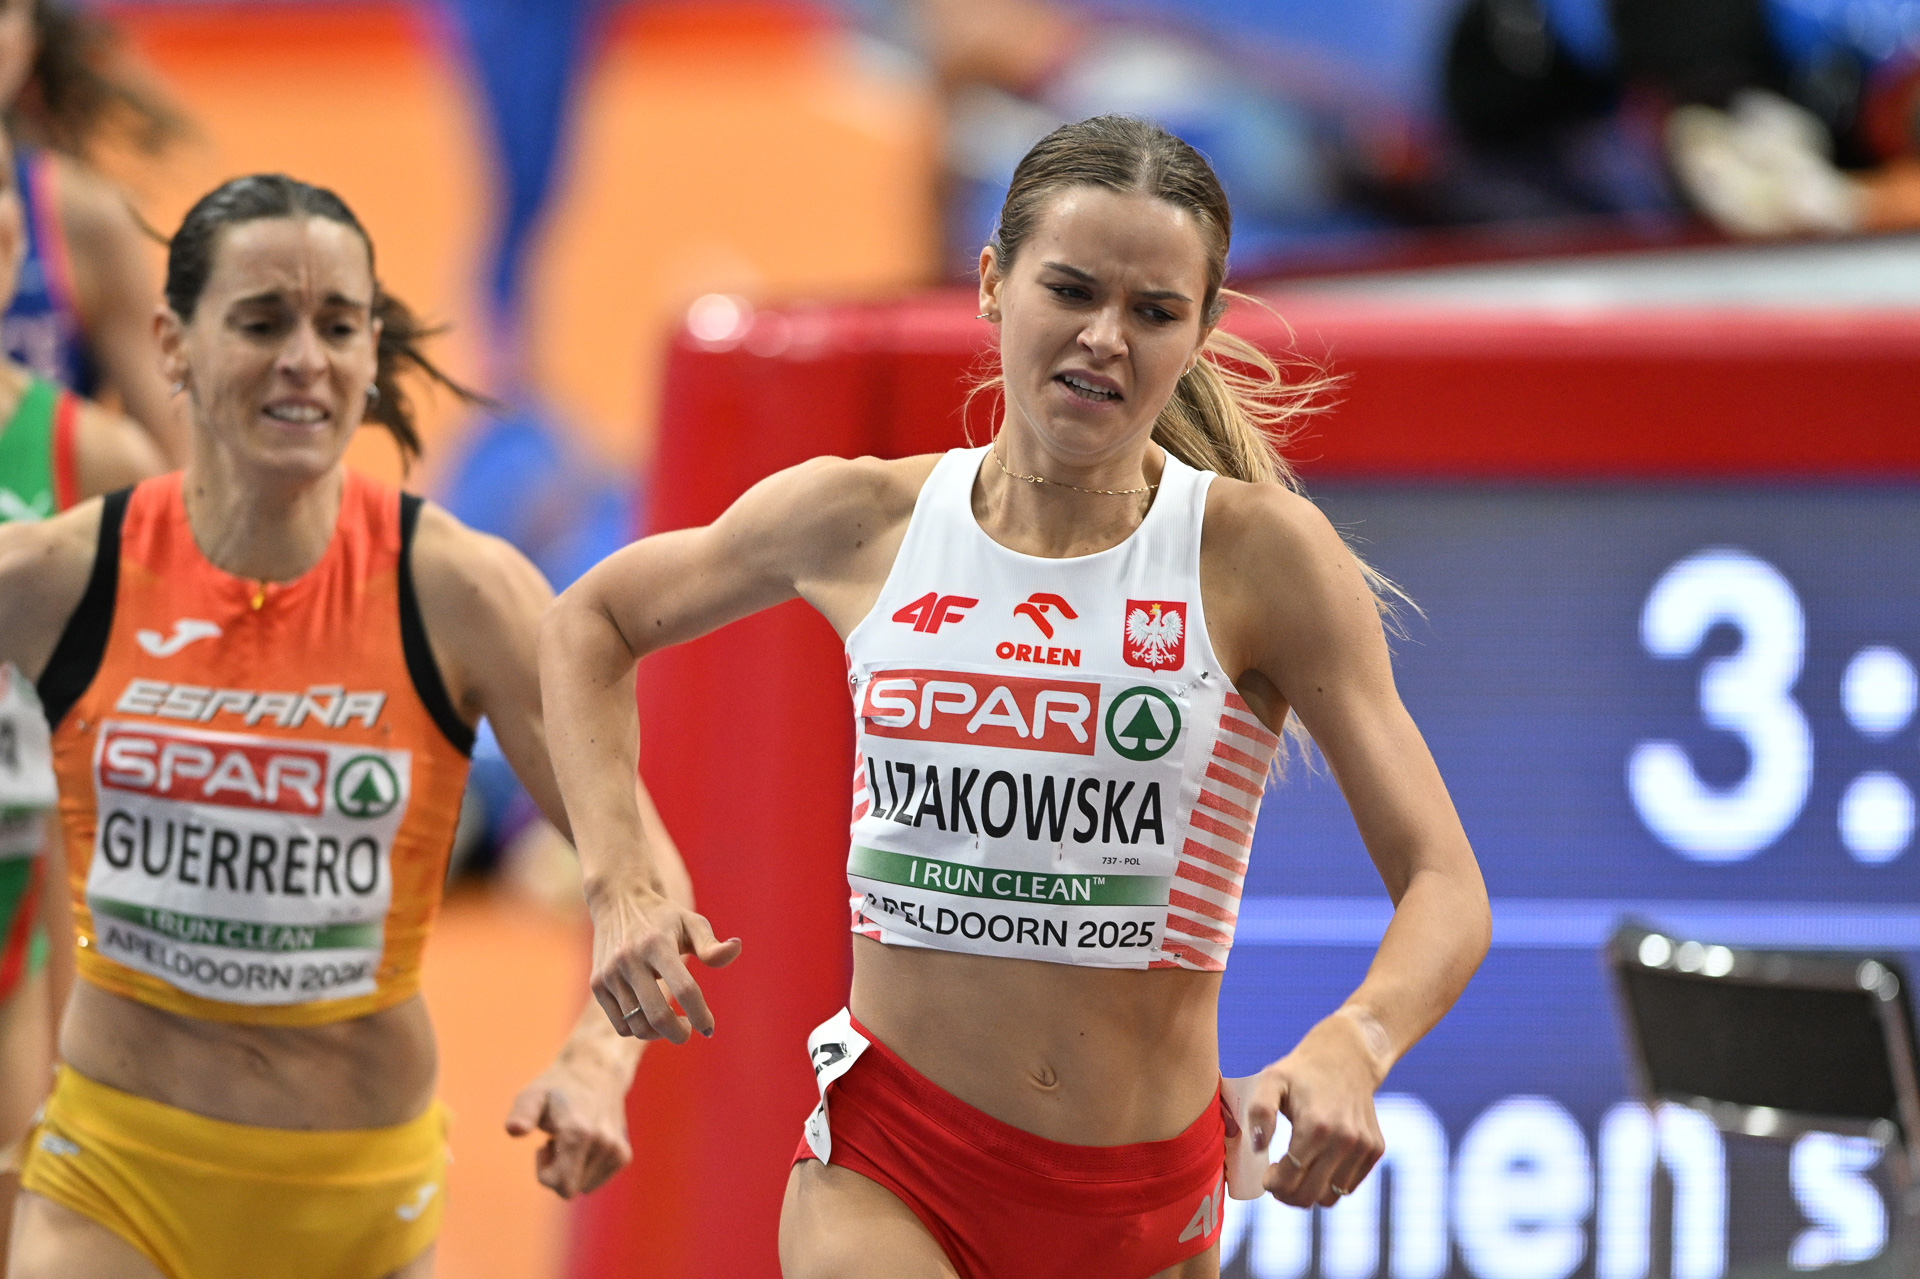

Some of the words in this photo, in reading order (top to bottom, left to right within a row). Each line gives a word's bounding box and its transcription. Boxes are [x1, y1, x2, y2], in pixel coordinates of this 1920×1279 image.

[891, 591, 980, 635] 4F
[995, 641, 1082, 668] ORLEN
[115, 678, 387, 729] ESPAÑA
[869, 679, 1092, 744] SPAR
[106, 737, 322, 808] SPAR
[868, 757, 1165, 845] LIZAKOWSKA
[102, 808, 381, 896] GUERRERO
[1102, 857, 1117, 865] 737
[1125, 857, 1141, 865] POL
[909, 860, 918, 883] I
[923, 862, 984, 893] RUN
[1078, 921, 1156, 949] 2025
